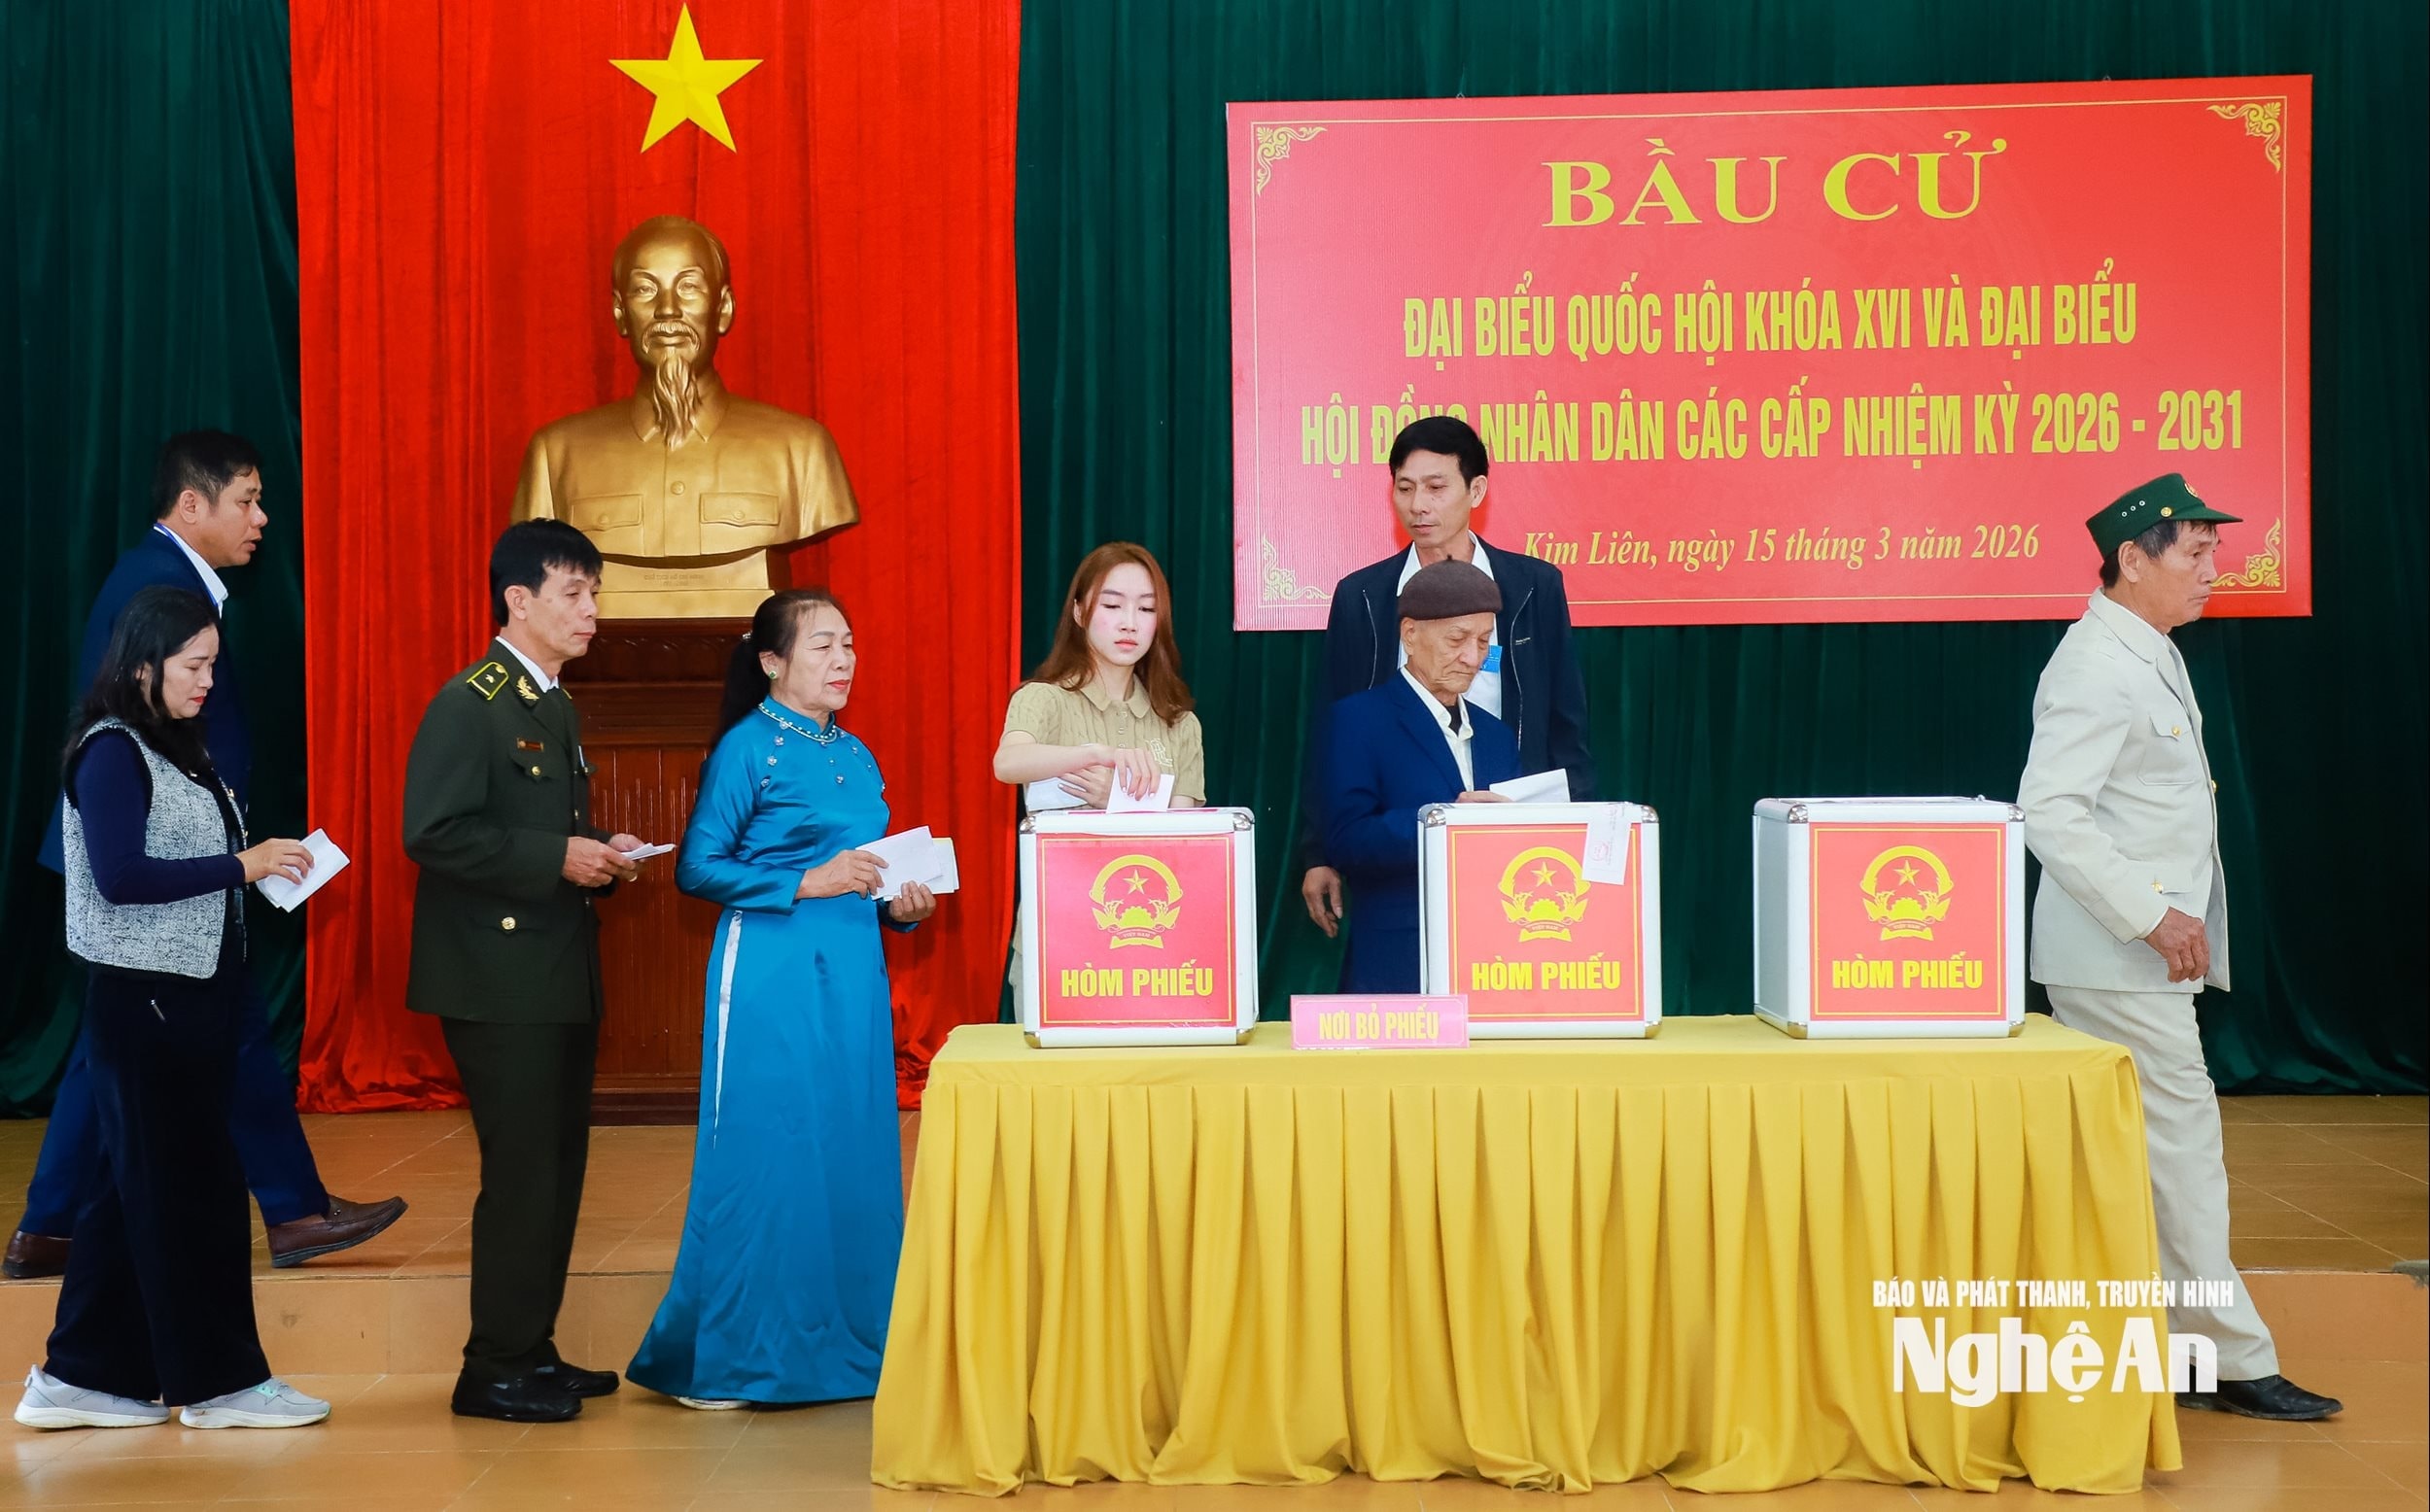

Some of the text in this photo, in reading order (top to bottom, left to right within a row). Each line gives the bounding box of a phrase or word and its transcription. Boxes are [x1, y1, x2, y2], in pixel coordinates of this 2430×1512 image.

[1542, 130, 2007, 227] BẦU CỬ
[1404, 257, 2137, 371] ĐẠI BIỂU QUỐC HỘI KHÓA XVI VÀ ĐẠI BIỂU
[1302, 393, 1359, 478] HỘI
[1479, 390, 1580, 464] NHÂN
[1591, 389, 1665, 462] DÂN
[1677, 386, 1748, 461] CÁC
[1760, 375, 1832, 459] CẤP
[1843, 382, 1962, 469] NHIỆM
[1974, 380, 2020, 455] KỲ
[2031, 392, 2120, 453] 2026
[2132, 419, 2146, 432] -
[2158, 390, 2242, 451] 2031
[1524, 523, 2039, 572] Kim Liên, ngày 15 tháng 3 năm 2026
[1060, 958, 1214, 998] HÒM PHIẾU
[1471, 952, 1621, 991] HÒM PHIẾU
[1831, 951, 1983, 989] HÒM PHIẾU
[1318, 1002, 1440, 1041] NƠI BỎ PHIẾU
